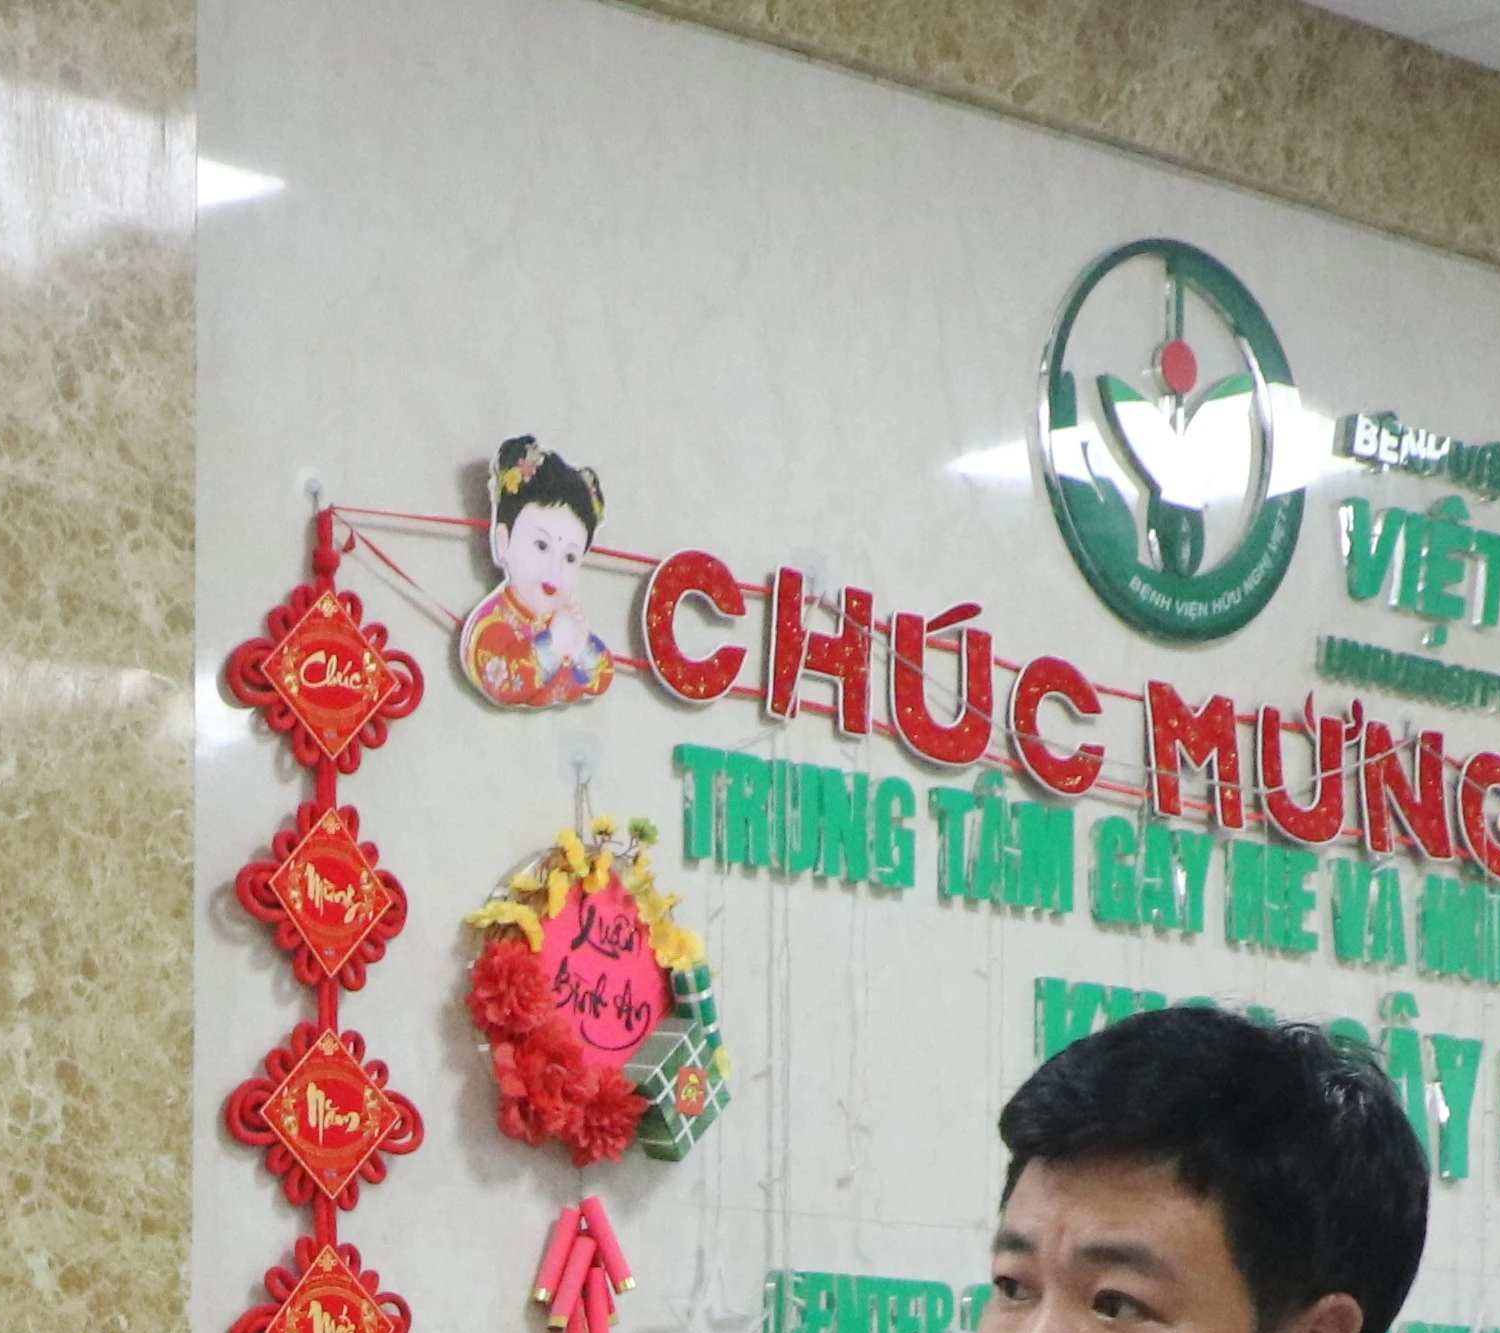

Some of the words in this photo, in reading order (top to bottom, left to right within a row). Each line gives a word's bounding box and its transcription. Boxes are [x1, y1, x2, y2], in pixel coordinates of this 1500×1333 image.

[300, 650, 363, 689] Chúc
[644, 548, 1105, 796] CHÚC
[673, 743, 915, 888] TRUNG
[928, 769, 1074, 914] TÂM
[306, 1081, 360, 1145] Năm
